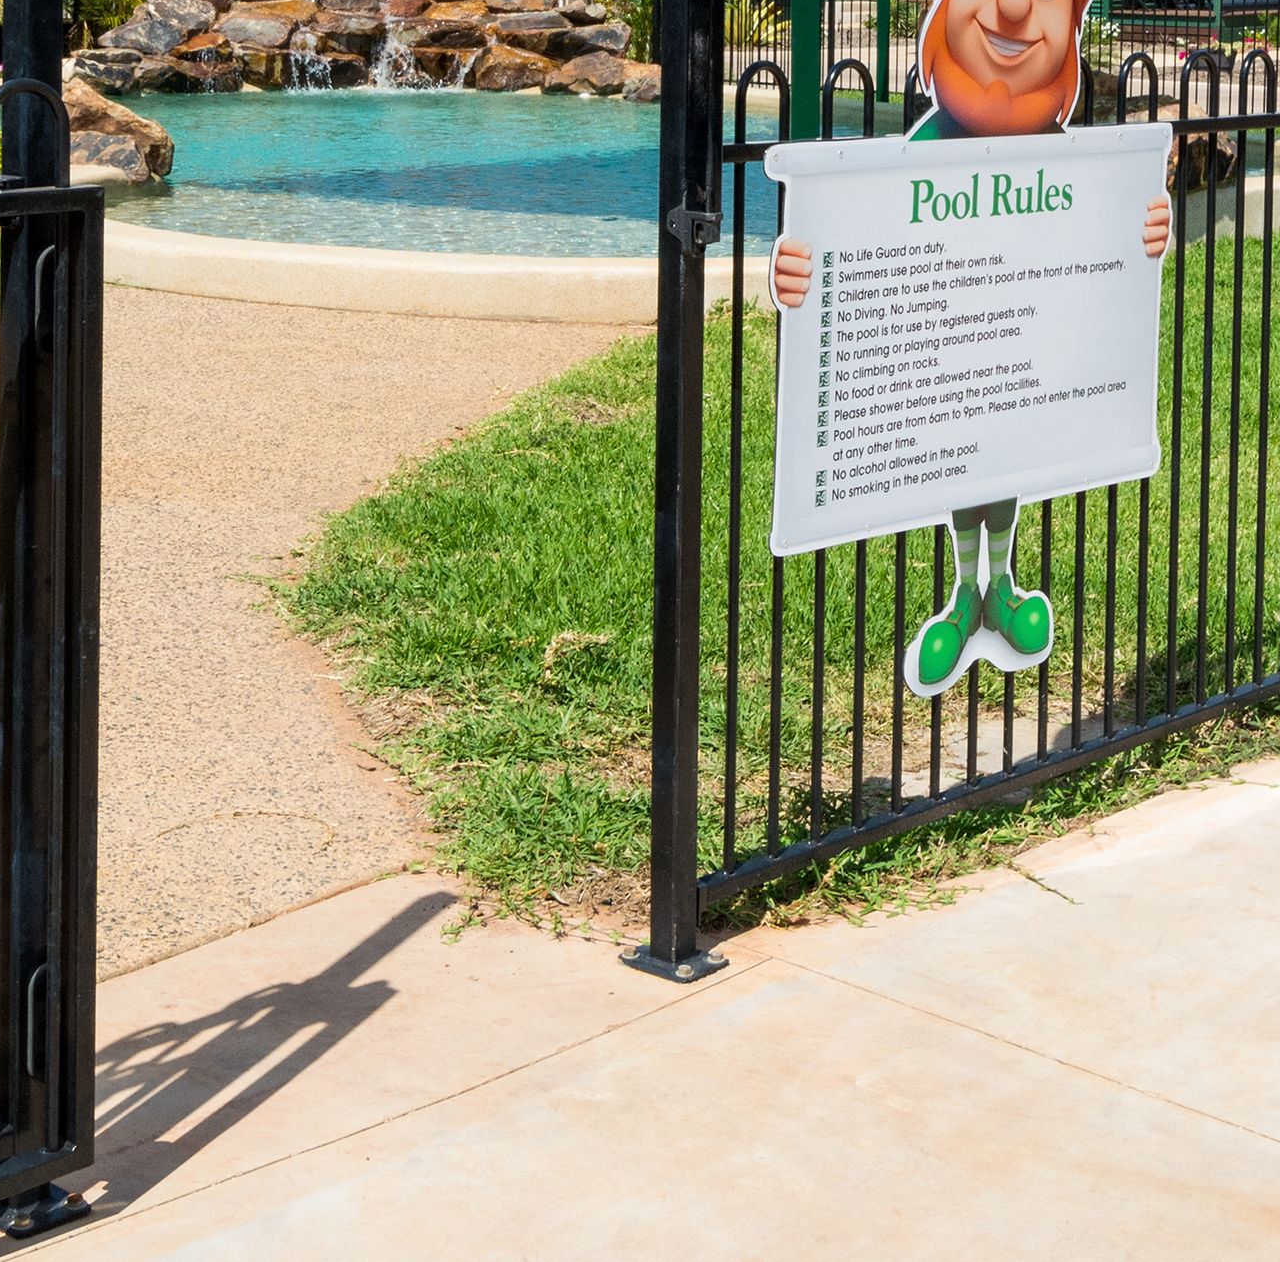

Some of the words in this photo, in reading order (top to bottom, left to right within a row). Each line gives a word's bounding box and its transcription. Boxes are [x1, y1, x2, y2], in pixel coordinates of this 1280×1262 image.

[909, 172, 979, 224] Pool
[990, 168, 1073, 217] Rules
[838, 268, 888, 284] Swimmers
[890, 266, 908, 277] use
[910, 261, 932, 277] pool
[933, 259, 944, 272] at
[945, 258, 966, 270] their
[967, 257, 987, 268] own
[989, 254, 1006, 266] risk.
[839, 251, 854, 264] No
[855, 248, 873, 262] Life
[875, 244, 907, 259] Guard
[908, 245, 921, 256] on
[923, 242, 947, 255] duty.
[838, 288, 880, 303] Children
[882, 286, 899, 297] are
[901, 283, 911, 295] to
[913, 283, 930, 294] use
[932, 279, 947, 291] the
[949, 273, 993, 289] children's
[994, 270, 1015, 286] pool
[1016, 269, 1026, 281] at
[1028, 268, 1042, 279] the
[1043, 266, 1063, 278] front
[1064, 264, 1073, 276] of
[1074, 263, 1088, 274] the
[1089, 259, 1125, 274] property.
[836, 330, 854, 343] The
[856, 325, 879, 343] pool
[881, 324, 889, 336] is
[891, 323, 904, 335] for
[906, 322, 923, 333] use
[924, 318, 937, 332] by
[939, 311, 985, 330] registered
[986, 308, 1015, 325] guests
[1017, 305, 1037, 318] only.
[837, 310, 852, 323] No
[854, 306, 887, 321] Diving.
[890, 303, 904, 316] No
[906, 298, 949, 314] Jumping.
[836, 350, 851, 363] No
[853, 345, 890, 360] running
[892, 344, 902, 354] or
[904, 337, 940, 355] playing
[942, 331, 975, 346] around
[977, 327, 998, 344] pool
[999, 327, 1022, 338] area.
[835, 370, 850, 383] No
[852, 363, 895, 380] climbing
[896, 362, 910, 373] on
[912, 356, 940, 370] rocks.
[835, 389, 849, 402] No
[851, 384, 875, 399] food
[876, 384, 887, 395] or
[889, 378, 913, 393] drink
[915, 377, 932, 389] are
[933, 369, 971, 386] allowed
[972, 367, 994, 379] near
[995, 364, 1010, 375] the
[1011, 359, 1033, 375] pool.
[833, 426, 855, 442] Pool
[857, 423, 884, 437] hours
[886, 420, 903, 432] are
[905, 416, 927, 428] from
[928, 412, 950, 424] 6am
[952, 408, 962, 420] to
[963, 406, 986, 419] 9pm.
[988, 400, 1017, 413] Please
[1019, 396, 1031, 408] do
[1033, 393, 1047, 405] not
[1048, 390, 1071, 403] enter
[1072, 387, 1086, 398] the
[1087, 383, 1106, 398] pool
[1107, 381, 1126, 392] area
[834, 407, 867, 422] Please
[869, 401, 904, 416] shower
[906, 395, 937, 409] before
[939, 390, 964, 403] using
[966, 387, 980, 399] the
[982, 382, 1003, 399] pool
[1004, 378, 1041, 392] facilities.
[832, 448, 843, 462] at
[845, 447, 865, 460] any
[867, 441, 893, 455] other
[895, 437, 918, 449] time.
[832, 468, 847, 481] No
[849, 459, 887, 478] alcohol
[888, 451, 927, 470] allowed
[929, 450, 938, 462] in
[940, 447, 955, 460] the
[957, 442, 980, 459] pool.
[832, 488, 846, 501] No
[848, 480, 890, 498] smoking
[892, 476, 901, 488] in
[903, 474, 919, 486] the
[921, 467, 943, 485] pool
[944, 465, 968, 477] area.
